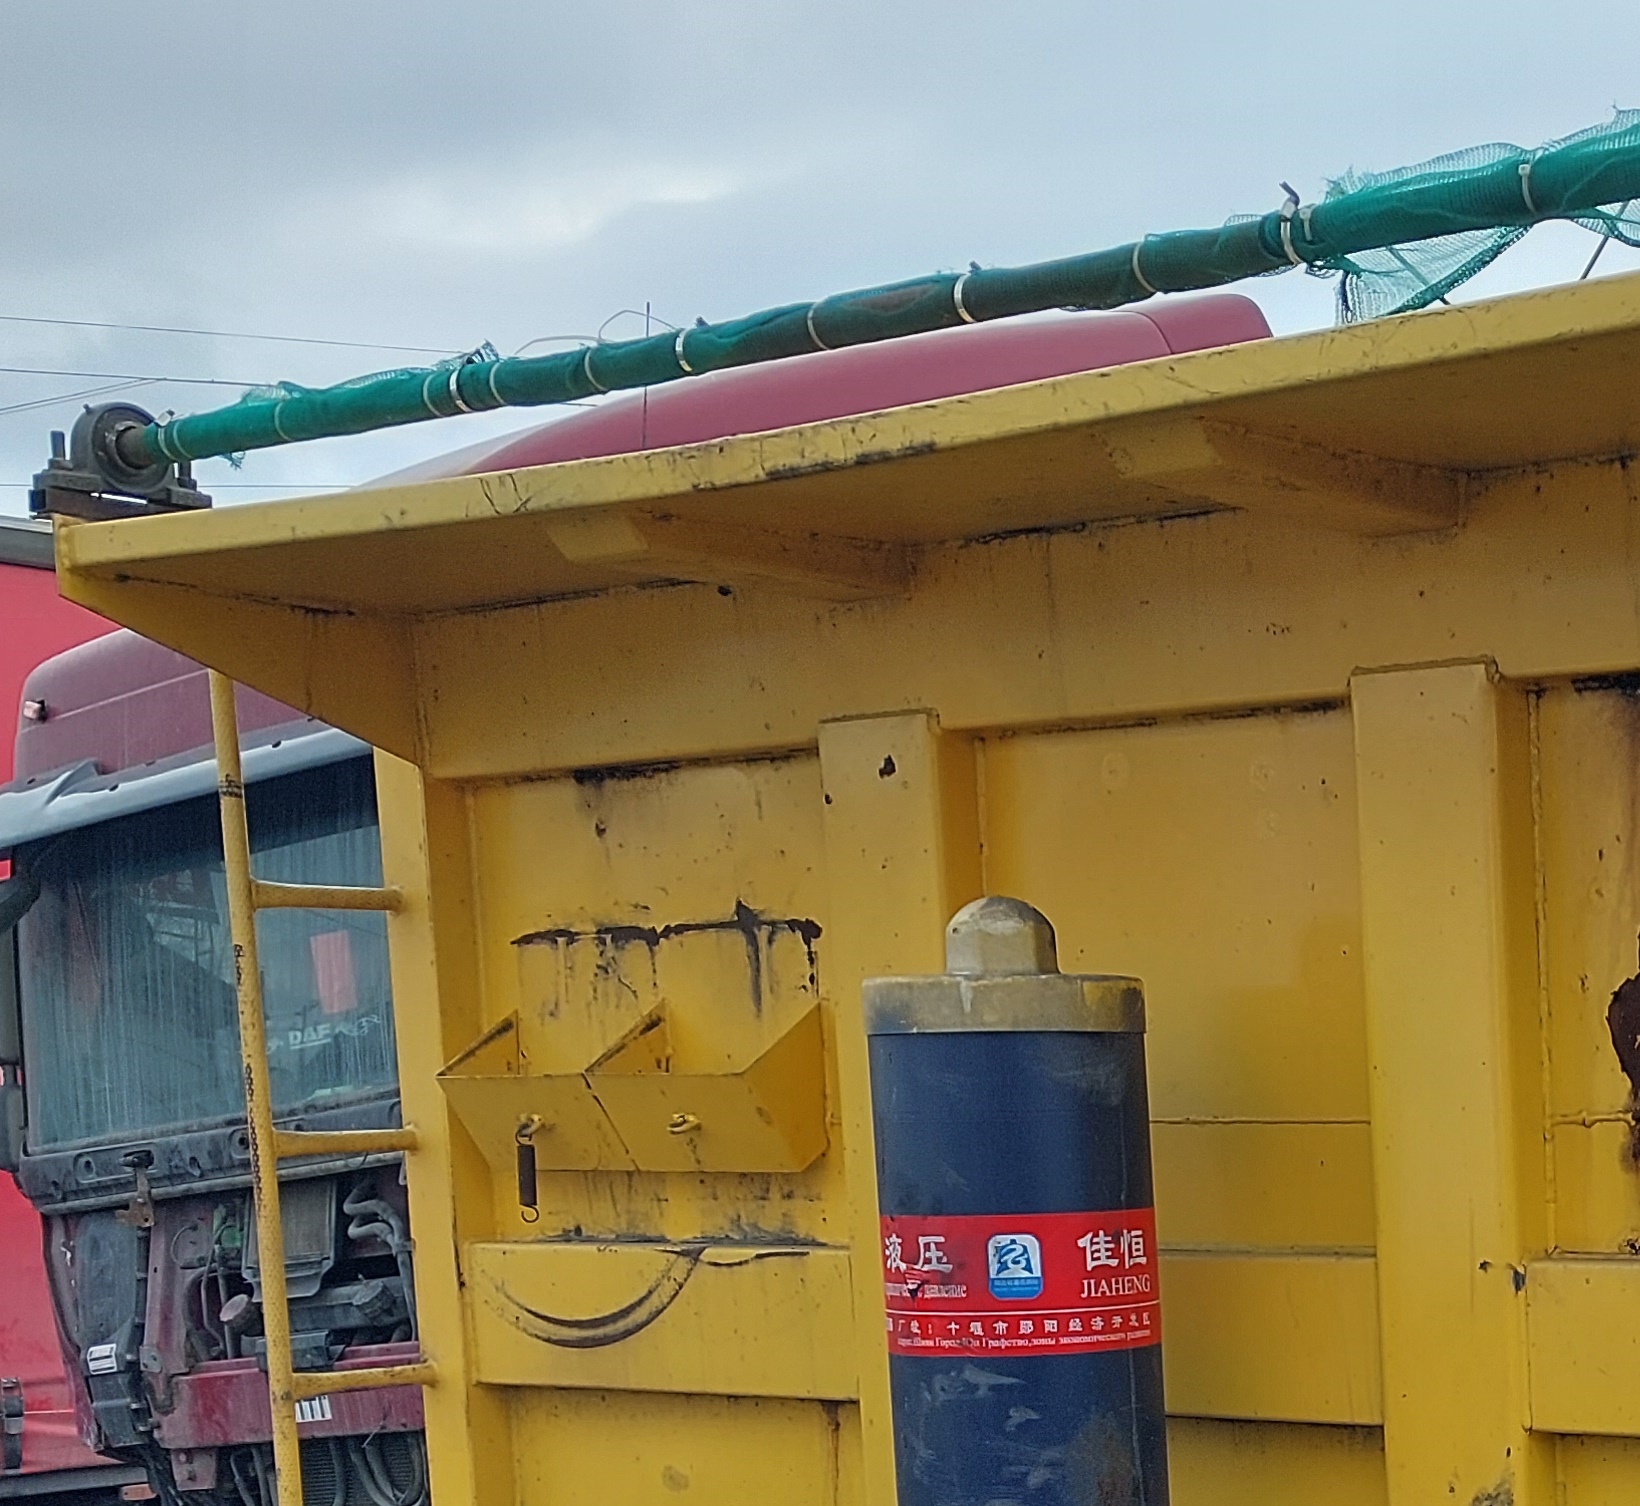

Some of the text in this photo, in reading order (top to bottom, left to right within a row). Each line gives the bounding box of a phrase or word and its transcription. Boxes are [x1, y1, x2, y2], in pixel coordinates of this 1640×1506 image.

[288, 1023, 331, 1046] DAF
[884, 1232, 954, 1273] 液压
[1076, 1229, 1147, 1271] 佳恒
[1080, 1273, 1151, 1298] JIAHENG
